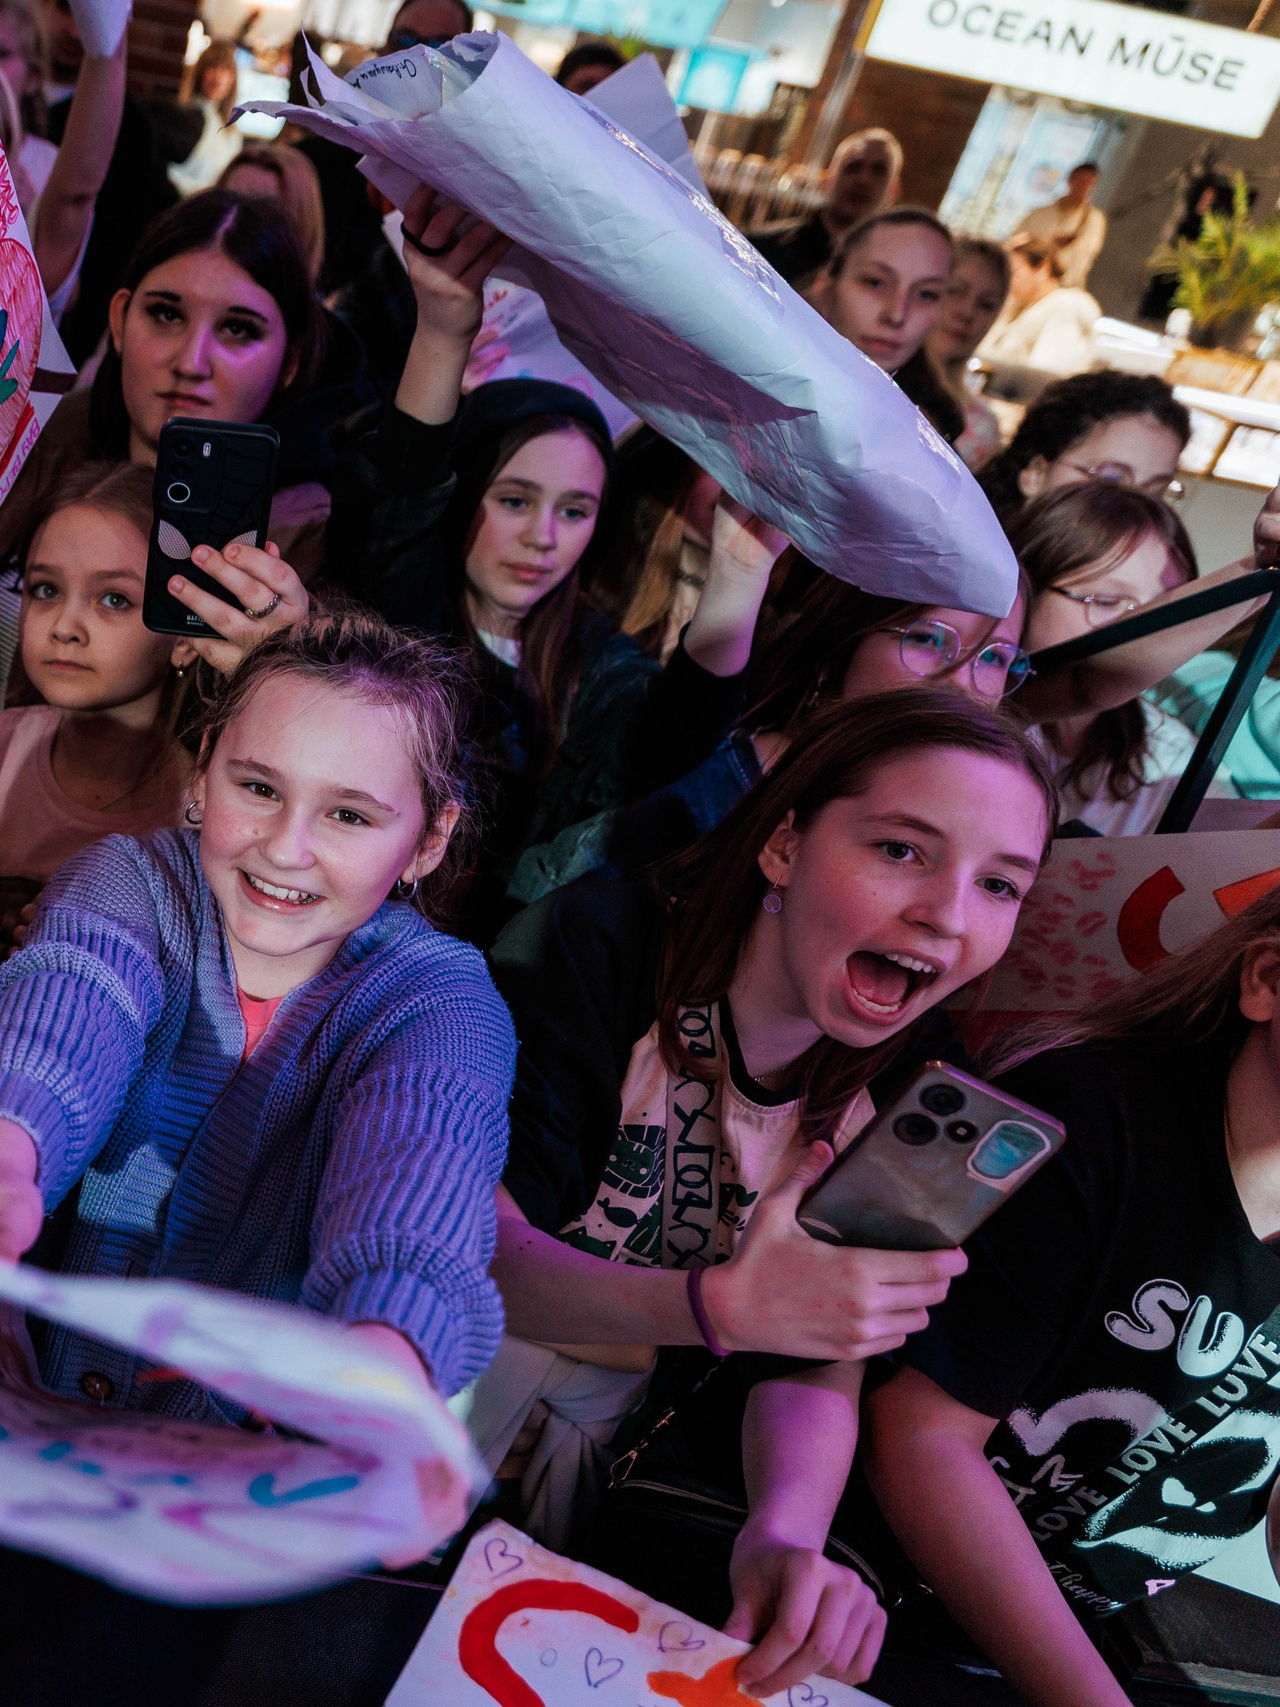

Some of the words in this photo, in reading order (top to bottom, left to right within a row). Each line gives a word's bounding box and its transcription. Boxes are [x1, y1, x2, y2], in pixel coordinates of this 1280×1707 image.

[927, 0, 1095, 56] OCEAN
[1031, 1487, 1108, 1542] LOVE
[1104, 1418, 1197, 1485] LOVE
